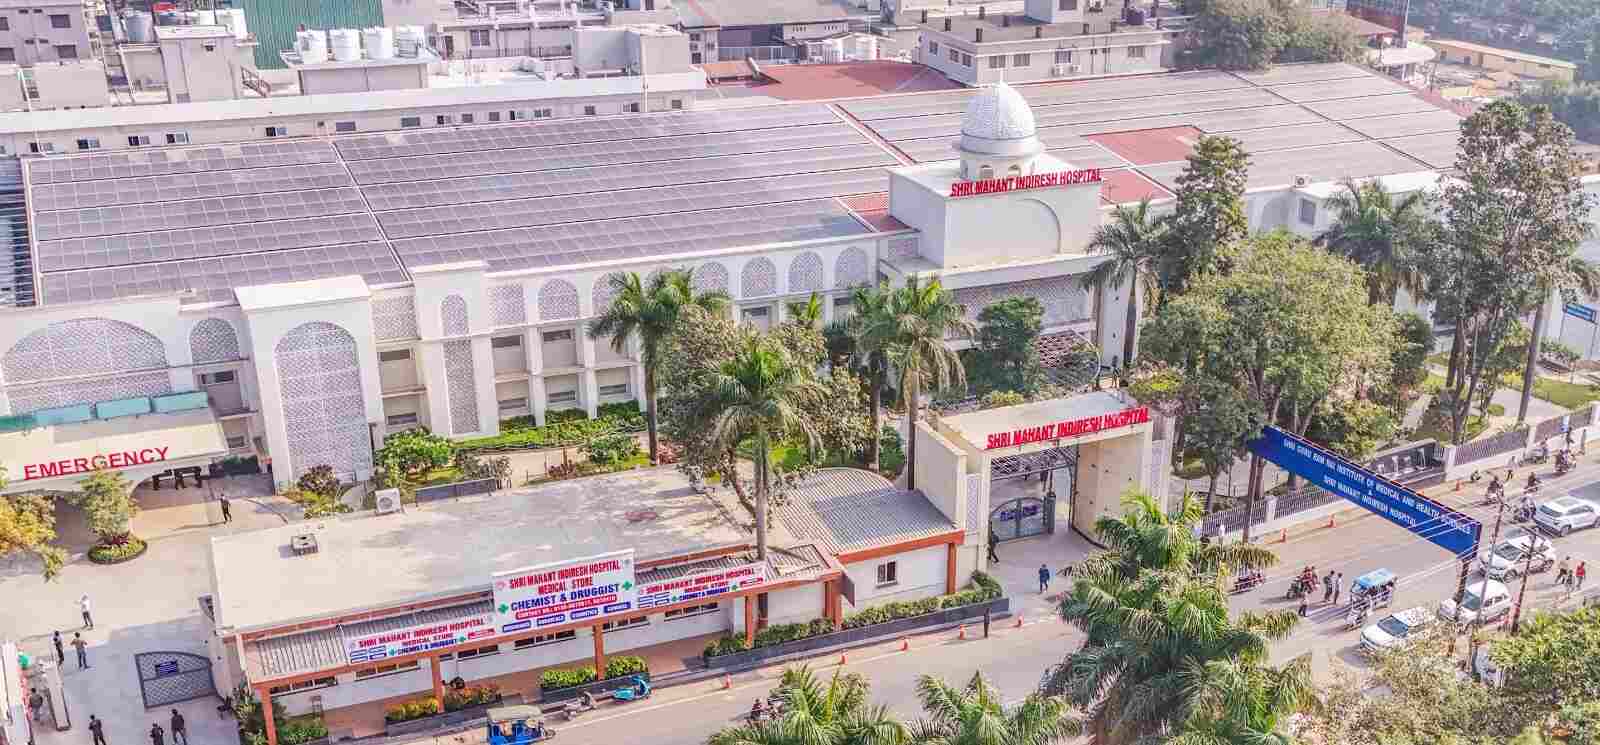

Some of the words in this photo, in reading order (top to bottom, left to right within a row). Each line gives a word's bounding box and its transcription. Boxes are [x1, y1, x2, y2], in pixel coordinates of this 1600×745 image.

[951, 182, 974, 197] SHRI
[975, 177, 1014, 194] MAHANT
[1016, 173, 1057, 190] INDIRESH
[1059, 168, 1103, 185] HOSPITAL
[986, 432, 1011, 449] SHRI
[1012, 423, 1055, 446] MAHANT
[1057, 415, 1101, 438] INDIRESH
[1103, 407, 1149, 430] HOSPITAL
[24, 446, 169, 481] EMERGENCY
[1336, 463, 1366, 487] INSTITUTE
[1366, 477, 1375, 488] OF
[1375, 481, 1401, 501] MEDICAL
[1402, 494, 1415, 508] AND
[1416, 502, 1441, 521] HEALTH
[1389, 507, 1417, 528] HOSPITAL
[510, 575, 527, 590] SHRI
[527, 571, 556, 587] MAHANT
[558, 565, 589, 580] INDIRESH
[589, 560, 620, 575] HOSPITAL
[537, 582, 566, 595] MEDICAL
[572, 576, 593, 590] STORE
[511, 594, 556, 611] CHEMIST
[560, 593, 568, 602] &
[570, 583, 620, 601] DRUGGIST
[449, 618, 485, 632] HOSPITAL
